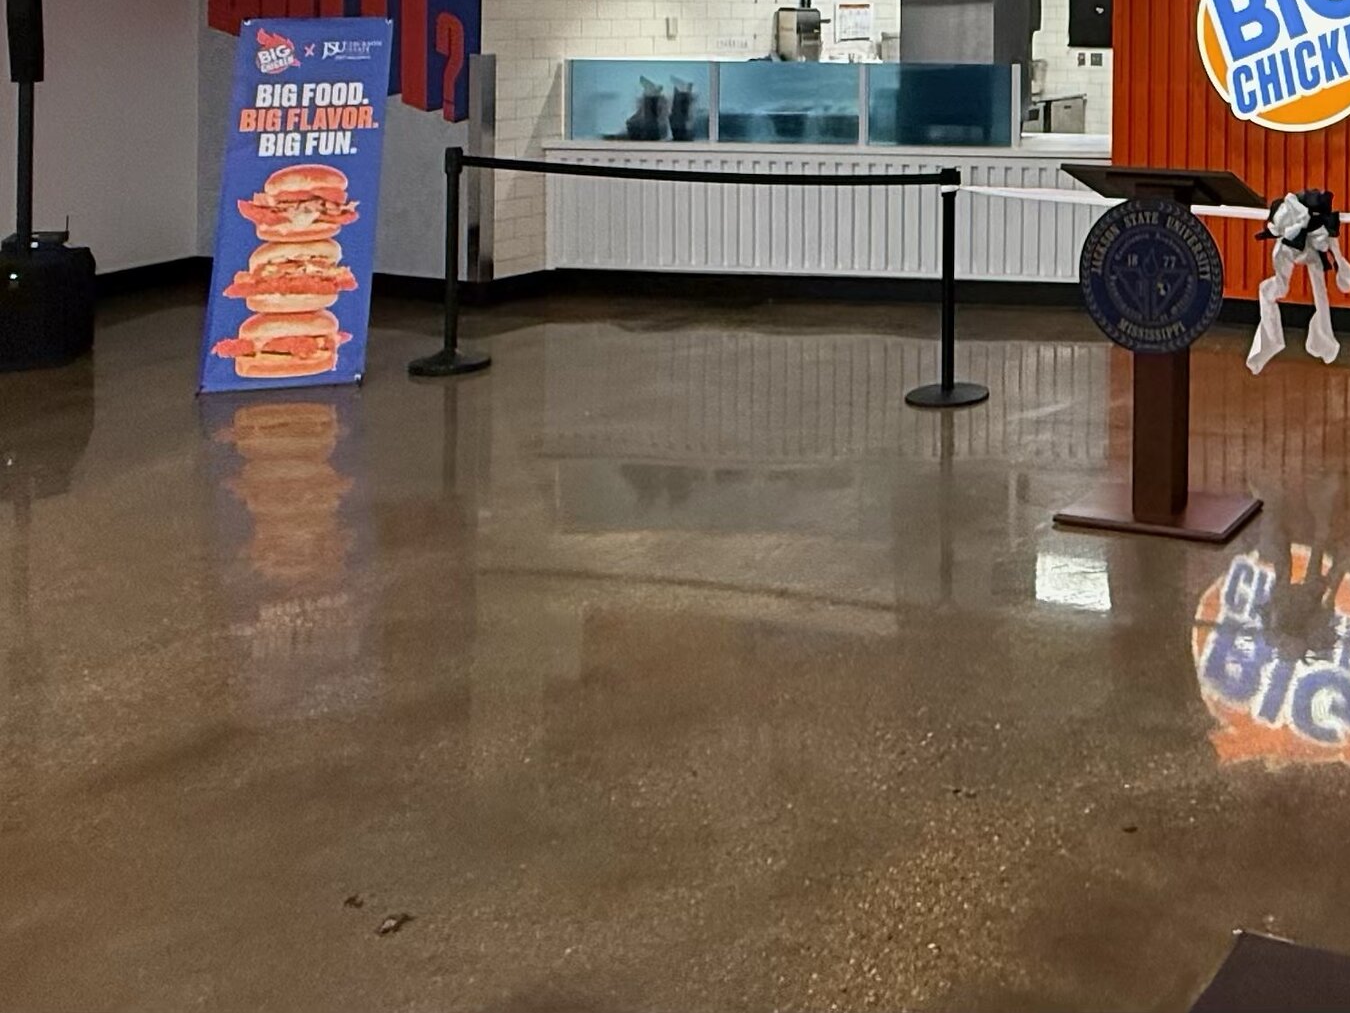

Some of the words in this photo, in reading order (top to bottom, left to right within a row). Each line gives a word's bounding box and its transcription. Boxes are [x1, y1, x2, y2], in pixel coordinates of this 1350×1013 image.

[258, 45, 291, 64] BIG
[322, 41, 346, 59] JSU
[255, 84, 298, 107] BIG
[302, 82, 369, 107] FOOD.
[239, 108, 282, 132] BIG
[286, 106, 379, 131] FLAVOR.
[258, 133, 301, 157] BIG
[305, 131, 358, 156] FUN.
[1123, 211, 1159, 228] STATE
